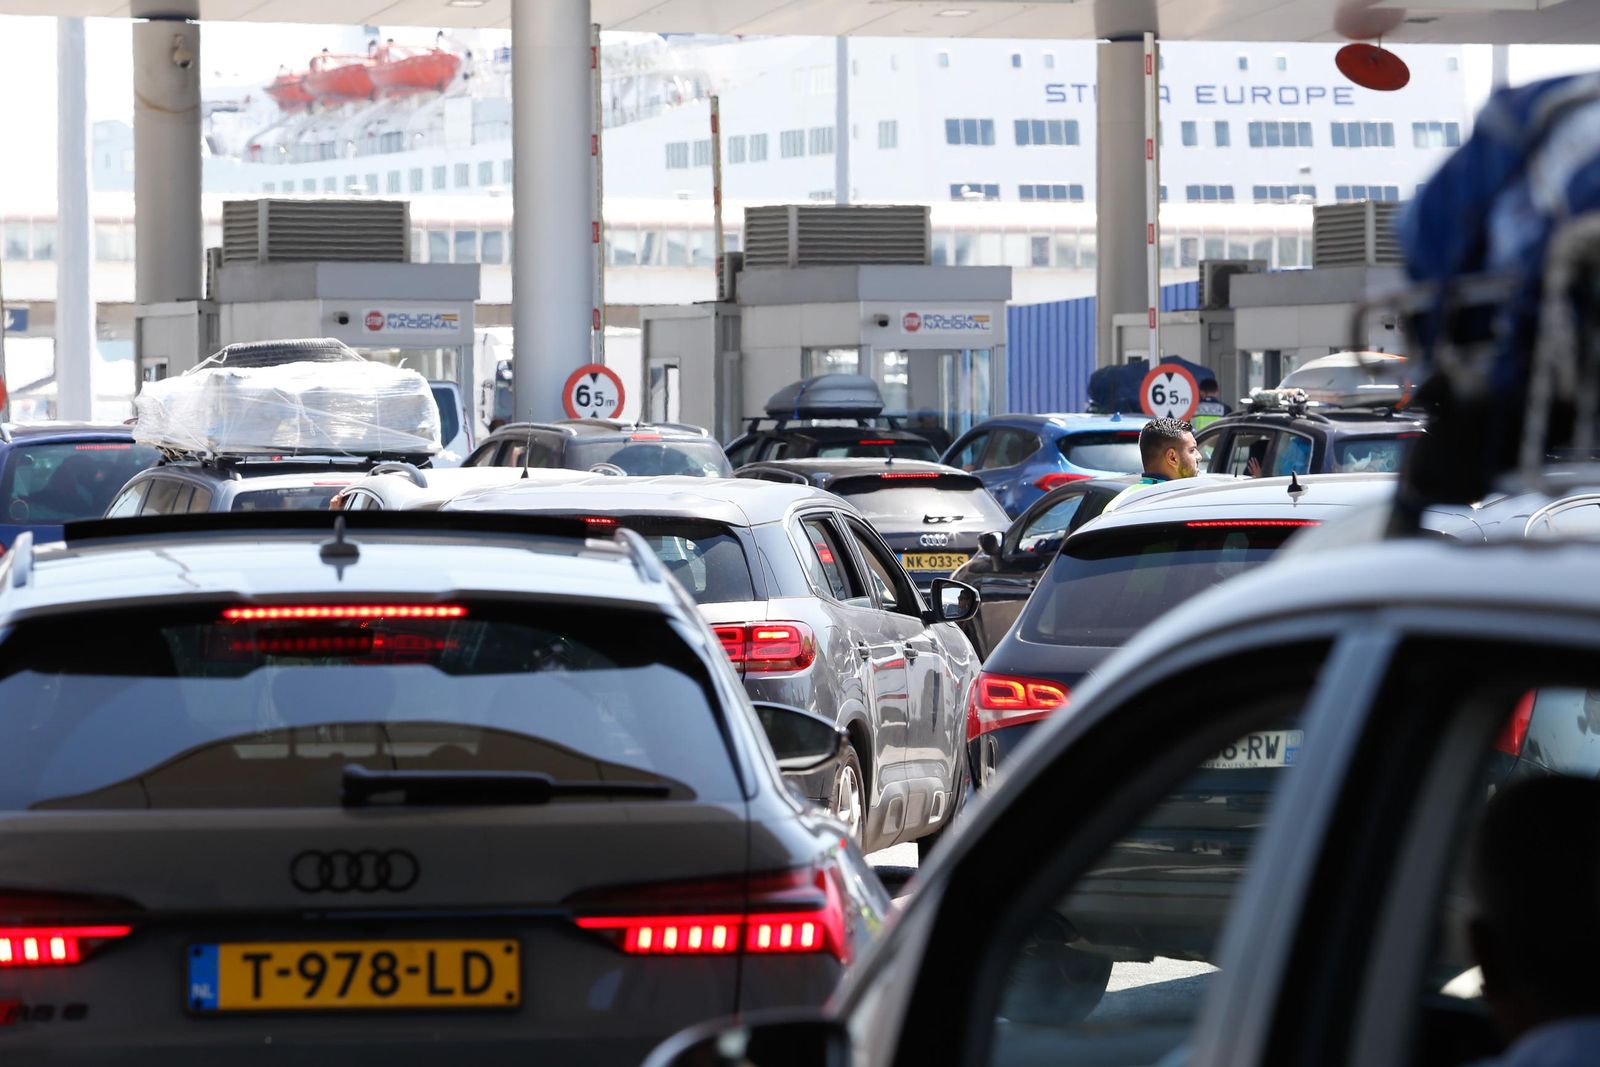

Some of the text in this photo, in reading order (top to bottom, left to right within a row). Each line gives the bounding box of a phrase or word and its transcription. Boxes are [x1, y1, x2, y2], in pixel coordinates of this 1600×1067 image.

[1196, 86, 1355, 105] EUROPE
[387, 320, 459, 330] NACIONAL
[923, 321, 989, 330] NACIONAL
[241, 950, 494, 1000] T-978-LD
[192, 982, 214, 999] NL
